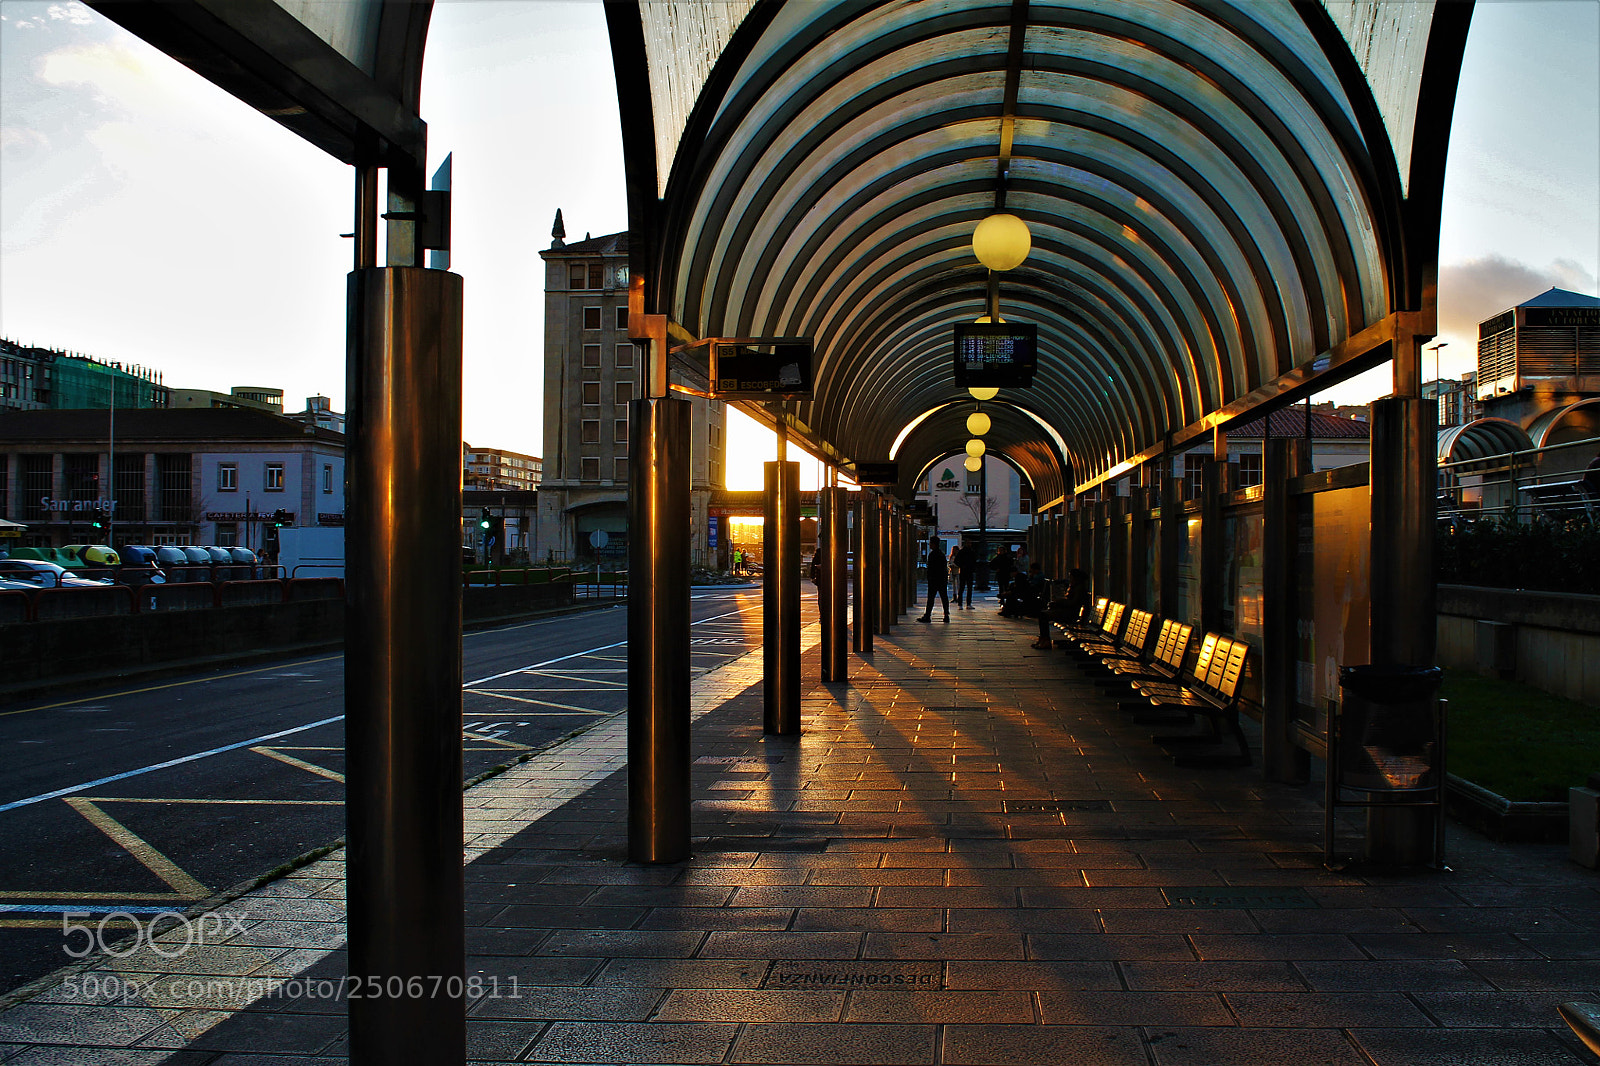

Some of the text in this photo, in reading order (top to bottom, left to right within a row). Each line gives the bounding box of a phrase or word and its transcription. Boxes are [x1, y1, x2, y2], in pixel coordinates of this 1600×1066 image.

[722, 348, 734, 357] S5
[723, 380, 735, 389] S6
[40, 496, 118, 512] Santander
[778, 972, 932, 987] DESCONFIANZA
